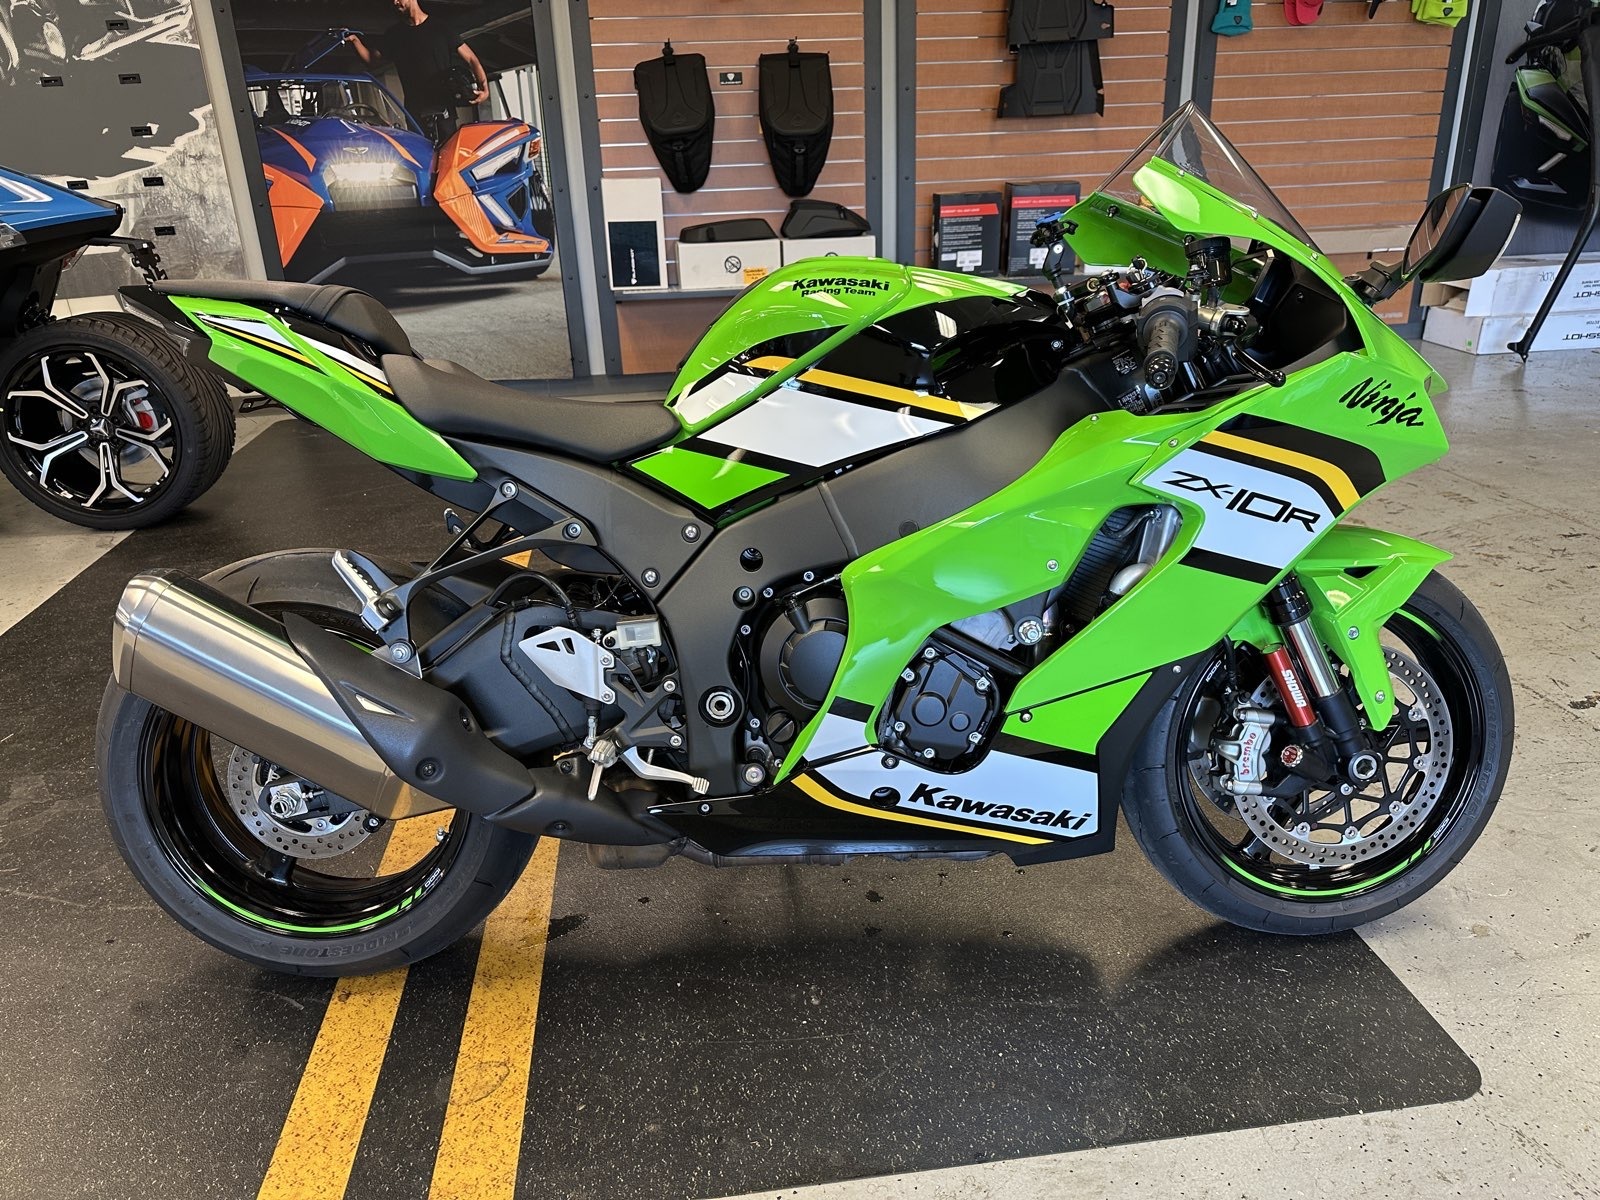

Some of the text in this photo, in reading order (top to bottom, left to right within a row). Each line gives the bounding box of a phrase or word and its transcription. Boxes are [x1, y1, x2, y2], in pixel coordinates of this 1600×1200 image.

[792, 277, 890, 291] Kawasaki
[844, 287, 876, 296] Team
[1338, 377, 1424, 427] Ninja
[1162, 470, 1321, 533] ZX-10R
[1281, 669, 1307, 708] SHOWA
[1240, 732, 1257, 776] brembo
[908, 783, 1093, 831] Kawasaki
